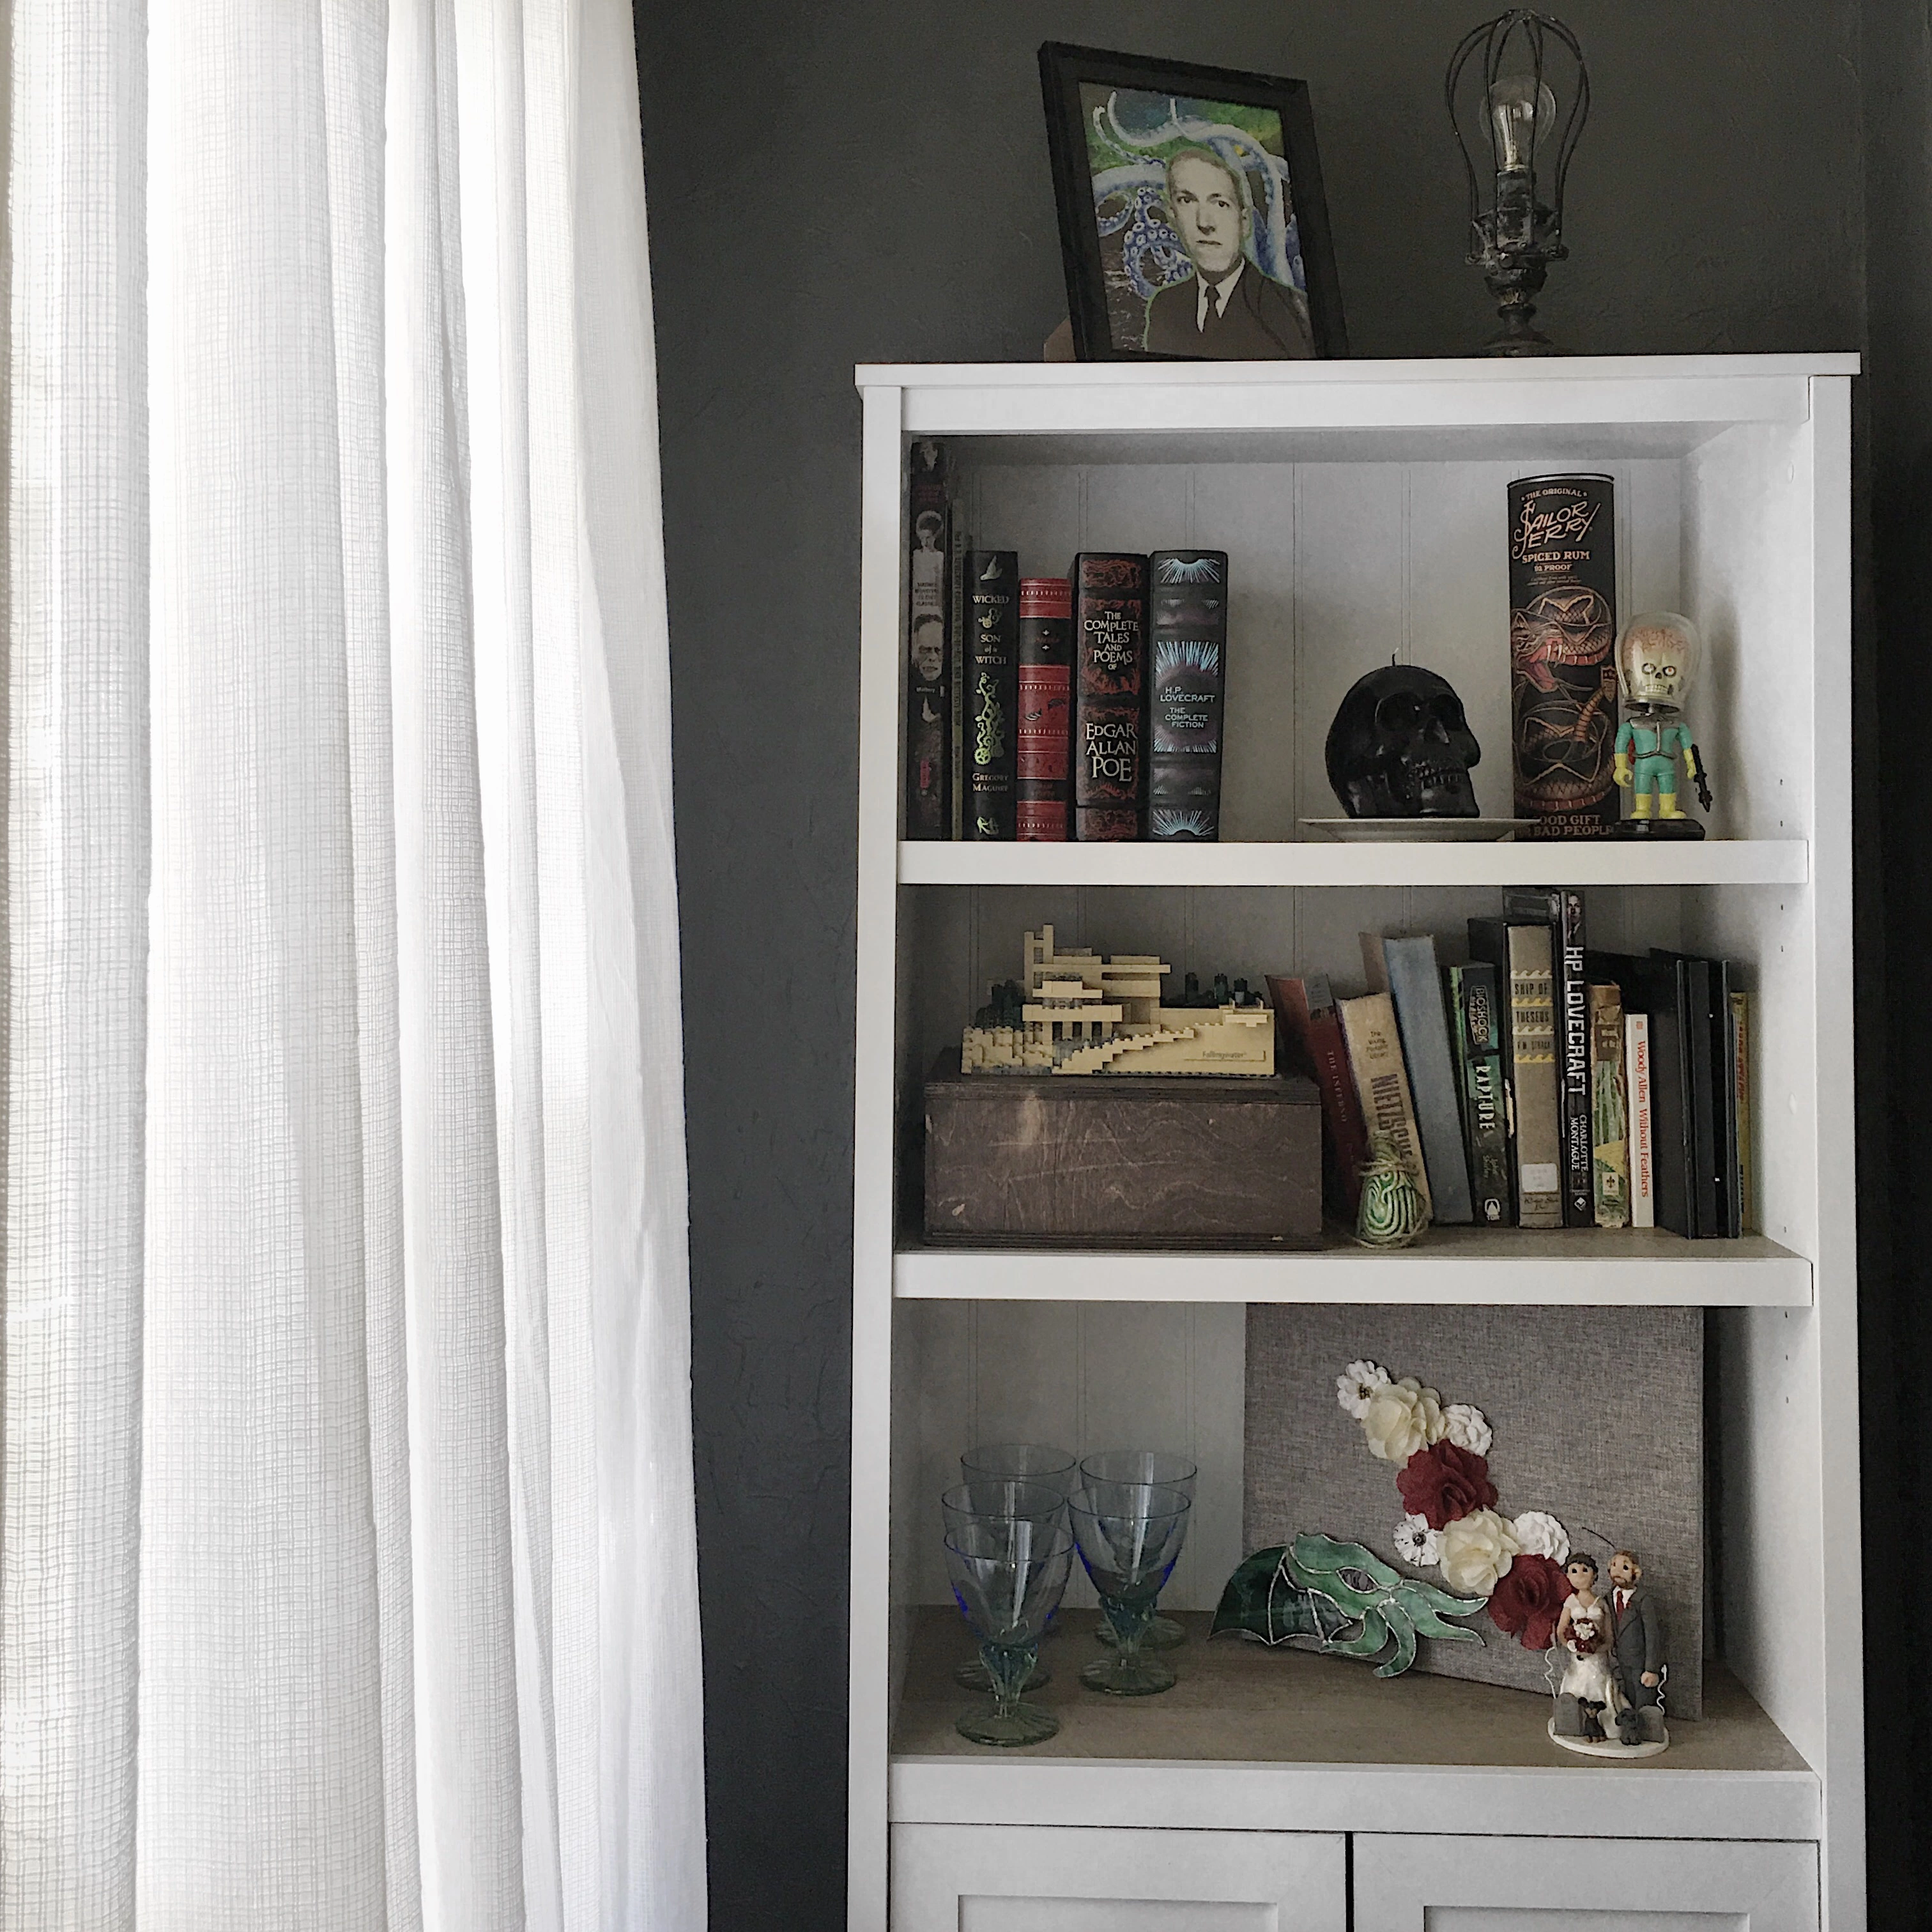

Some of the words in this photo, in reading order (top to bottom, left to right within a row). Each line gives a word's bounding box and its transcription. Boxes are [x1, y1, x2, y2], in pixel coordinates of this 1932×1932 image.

[1526, 490, 1541, 500] THE
[1542, 488, 1582, 496] ORIGINAL
[1522, 551, 1560, 564] SPICED
[1563, 551, 1590, 560] RUM
[972, 595, 1009, 604] WICKED
[1105, 611, 1121, 620] THE
[1084, 620, 1138, 632] COMPLETE
[980, 633, 1001, 643] SON
[1093, 631, 1130, 643] TALES
[976, 656, 1007, 664] WITCH
[1093, 650, 1133, 665] POEMS
[1086, 723, 1138, 740] EDGAR
[1086, 740, 1136, 756] ALLAN
[1092, 756, 1132, 781] POE
[1536, 815, 1567, 825] OOD
[1570, 815, 1600, 825] GIFT
[1534, 826, 1560, 836] BAD
[1565, 946, 1584, 971] HP
[1515, 983, 1533, 994] SHIP
[1538, 983, 1547, 994] OF
[1476, 988, 1487, 1041] BIOSHOCK
[1517, 1011, 1549, 1022] THESEUS
[1567, 980, 1586, 1095] LOVECRAFT
[1636, 1041, 1646, 1075] Woody
[1327, 1050, 1337, 1070] THE
[1332, 1075, 1347, 1123] INFERNO
[1638, 1077, 1647, 1102] Allen
[1476, 1066, 1496, 1129] RAPTURE
[1639, 1109, 1648, 1149] Without
[1570, 1117, 1579, 1170] MONTAGUE
[1579, 1114, 1588, 1171] CHARLOTTE
[1641, 1153, 1650, 1197] Feathers
